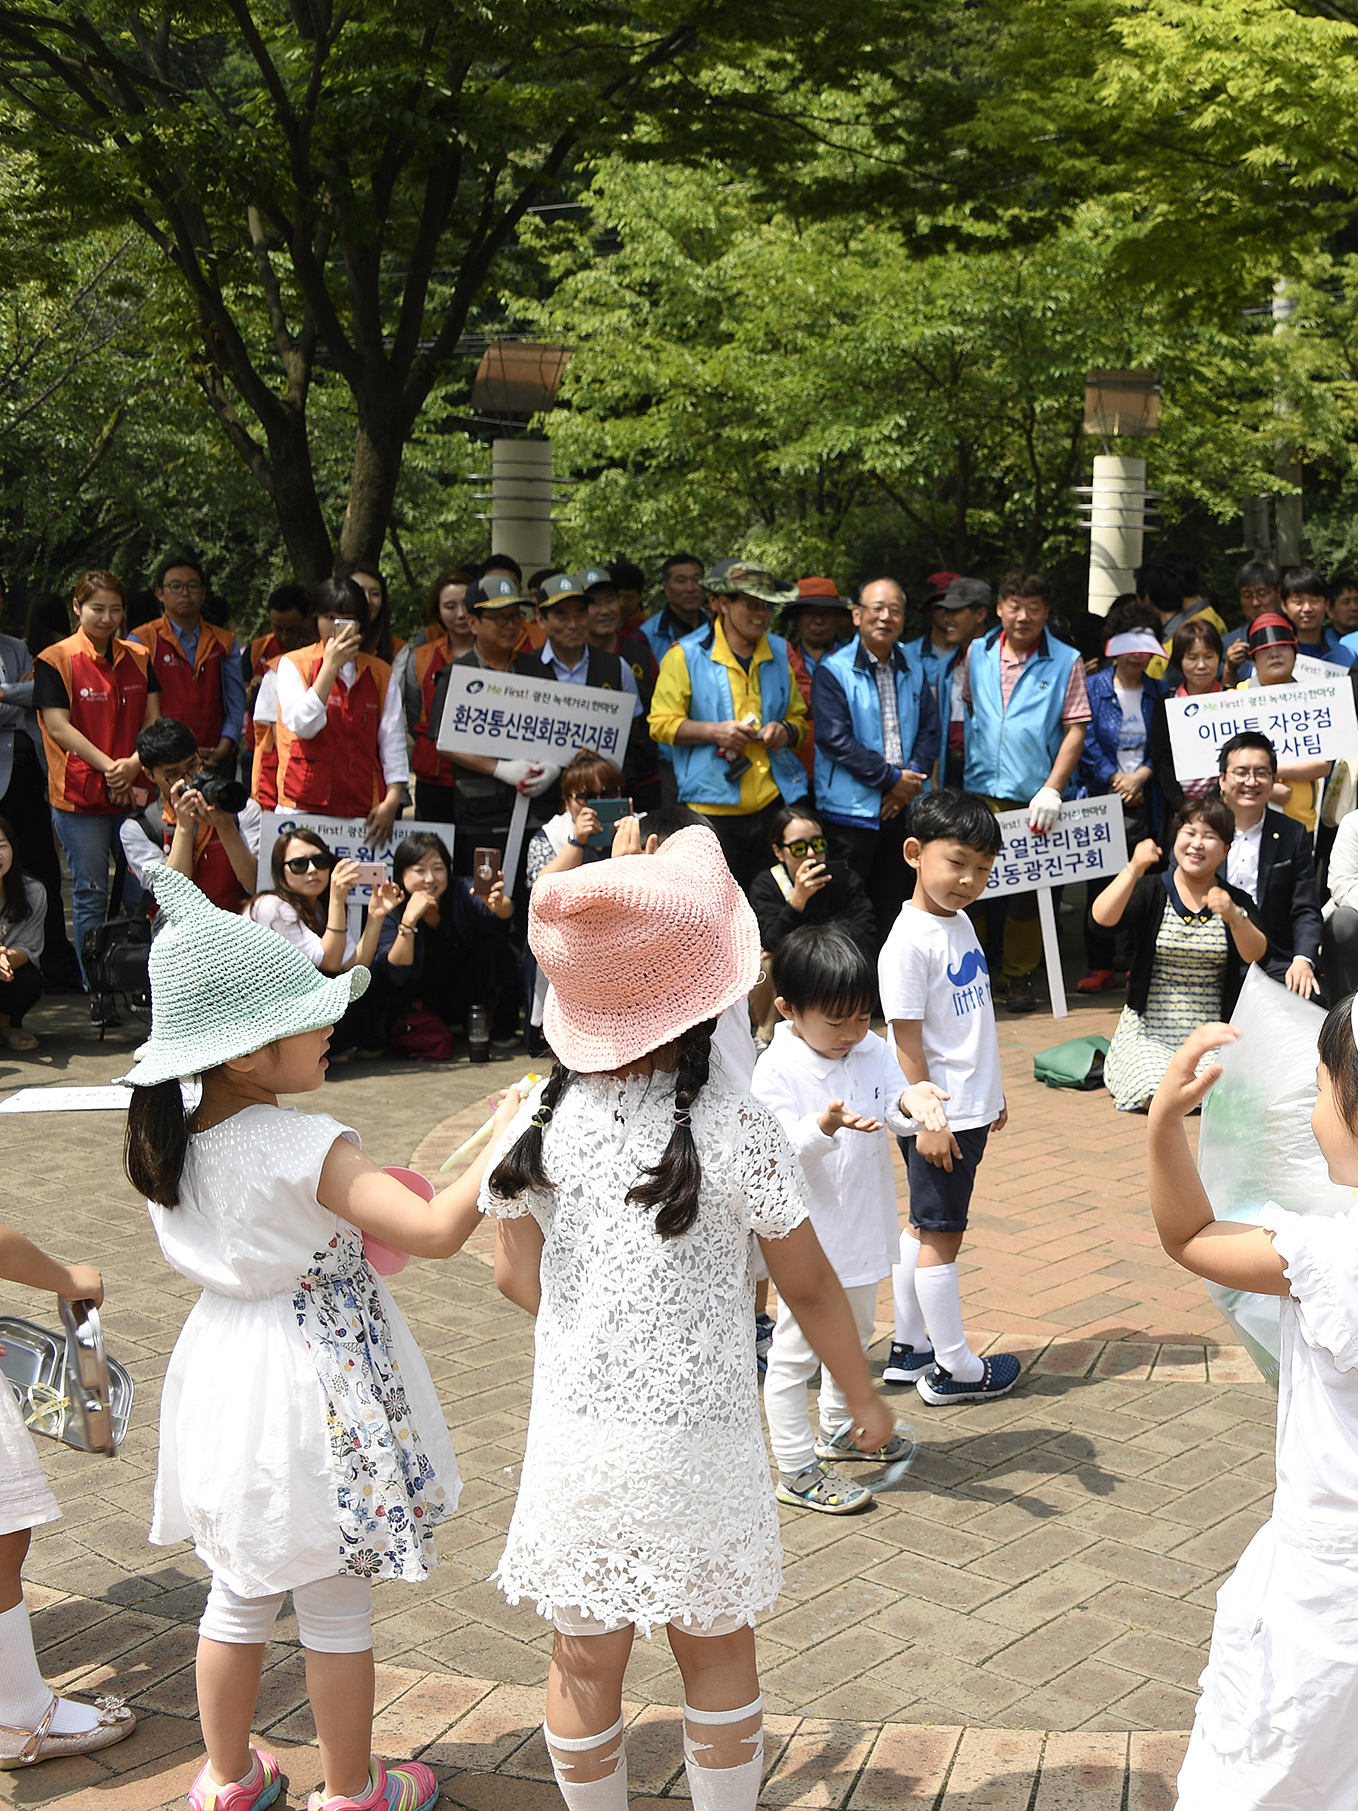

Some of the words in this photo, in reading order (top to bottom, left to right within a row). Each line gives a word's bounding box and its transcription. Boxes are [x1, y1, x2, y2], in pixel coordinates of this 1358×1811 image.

[486, 683, 502, 696] Me
[503, 686, 529, 700] First!
[532, 690, 551, 705] 광진
[553, 694, 590, 711] 녹색거리
[591, 700, 620, 715] 한마당
[1203, 702, 1218, 712] Me
[1220, 698, 1245, 710] First!
[1248, 695, 1267, 708] 광진
[1269, 691, 1308, 705] 녹색거리
[1307, 686, 1336, 699] 한마당
[452, 704, 620, 755] 환경통신원회광진지회
[1268, 707, 1332, 734] 자양점
[1080, 804, 1108, 819] 한마당
[317, 823, 343, 837] First!
[347, 825, 367, 839] 광진
[953, 985, 985, 1016] little
